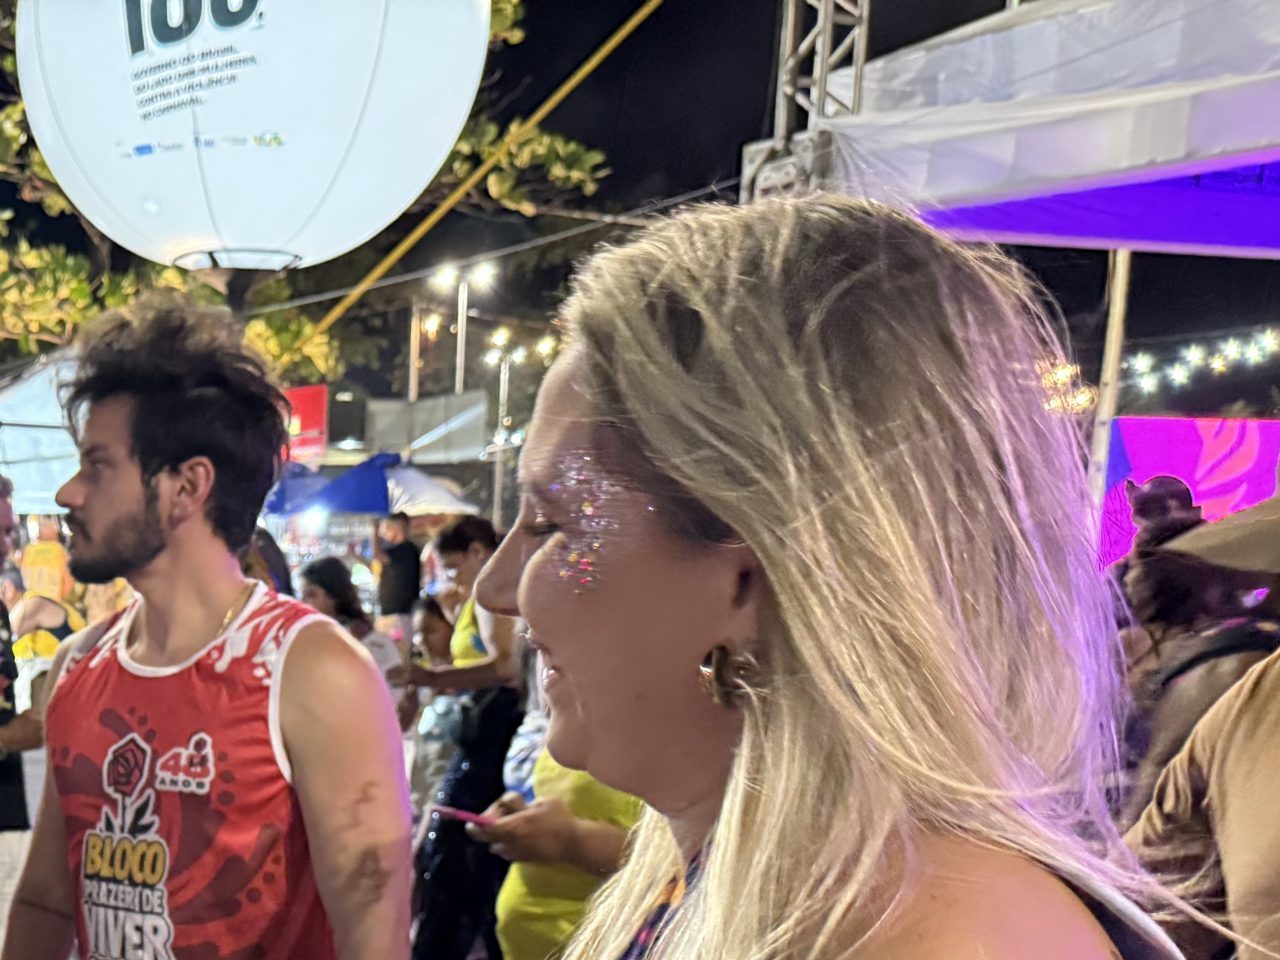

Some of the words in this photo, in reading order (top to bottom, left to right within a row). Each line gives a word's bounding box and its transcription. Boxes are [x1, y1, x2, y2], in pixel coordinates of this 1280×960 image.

[158, 777, 206, 790] ANOS
[85, 832, 167, 887] BLOCO
[141, 886, 164, 915] DE
